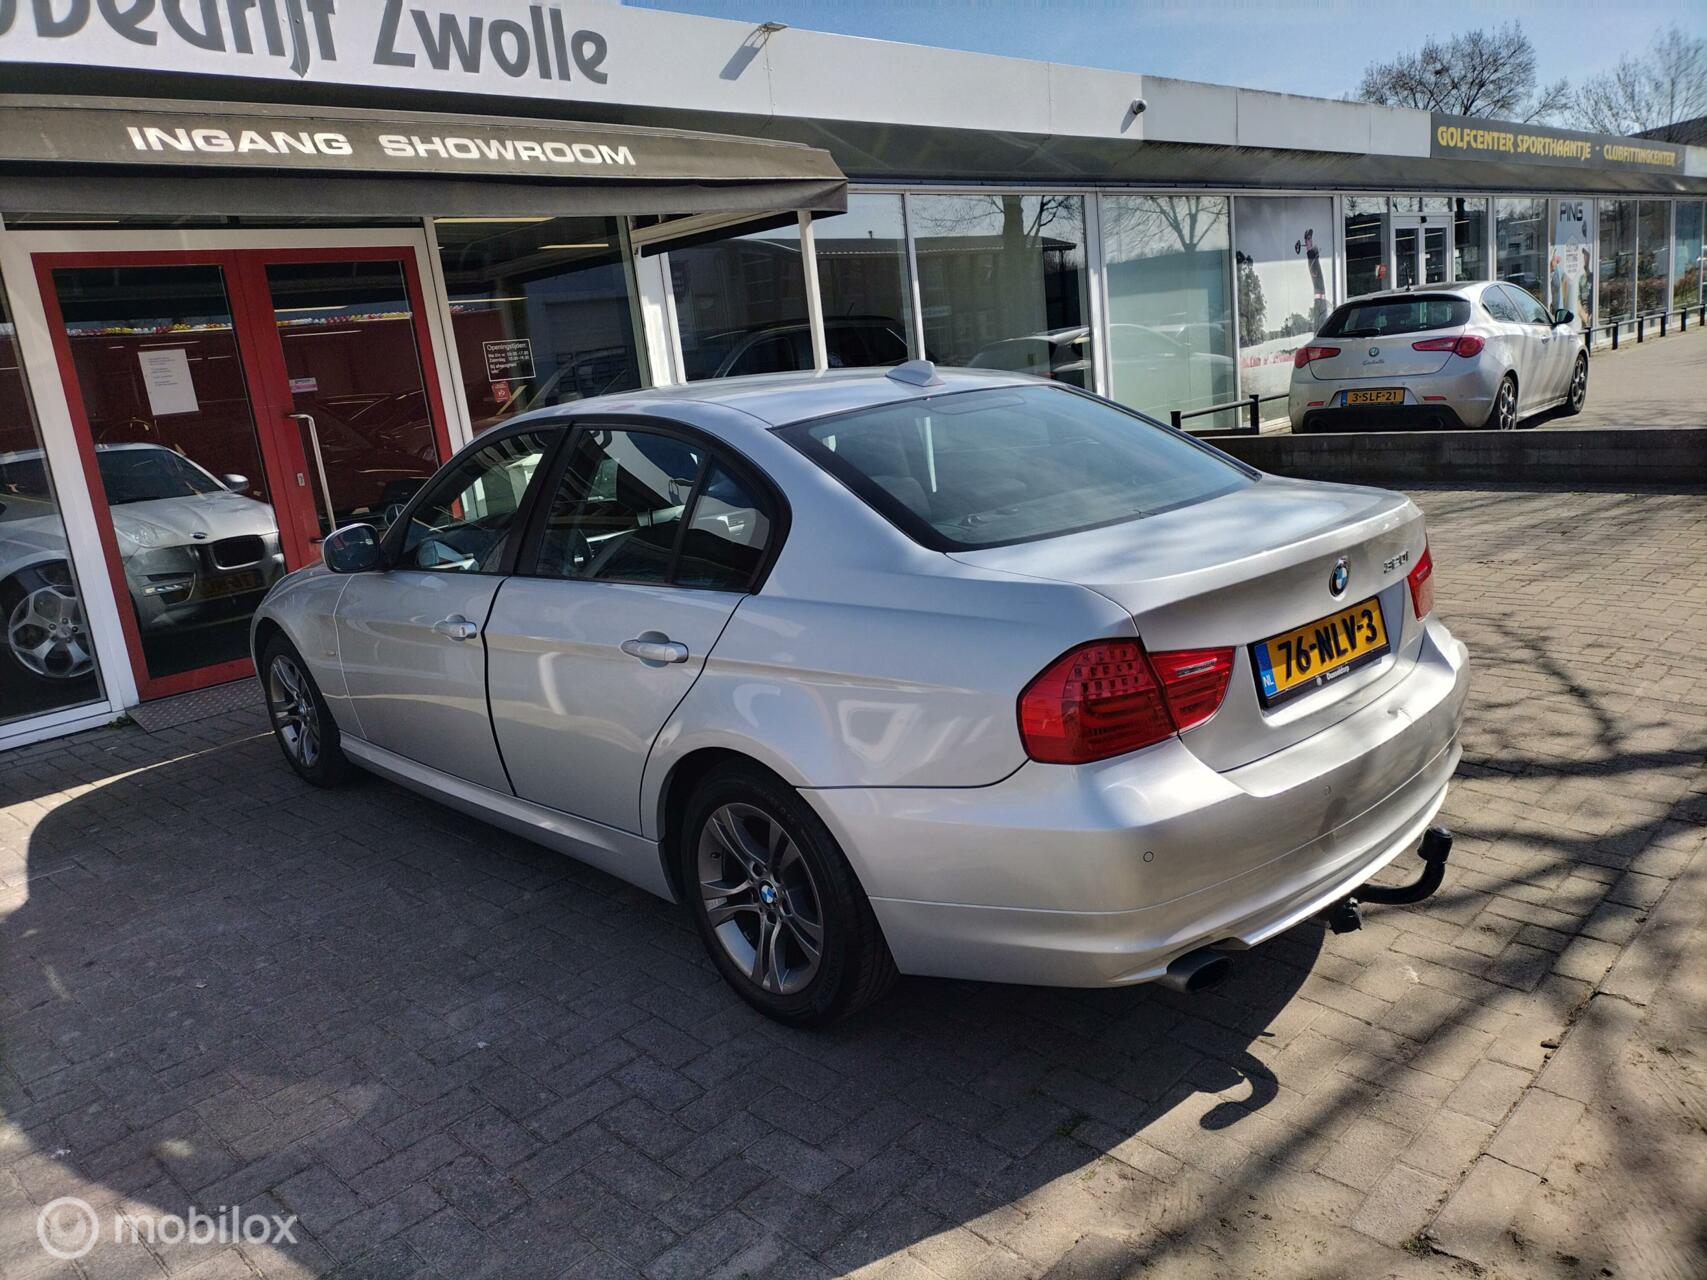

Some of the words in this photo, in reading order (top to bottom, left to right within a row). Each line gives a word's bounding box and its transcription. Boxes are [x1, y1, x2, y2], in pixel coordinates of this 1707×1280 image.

[373, 0, 608, 85] Zwolle
[127, 126, 353, 156] INGANG
[379, 135, 636, 166] SHOWROOM
[1437, 126, 1514, 152] GOLFCENTER
[1559, 201, 1584, 221] PING
[1352, 391, 1397, 402] 3-SLF-21
[1278, 609, 1378, 682] 76-NLV-3
[1262, 674, 1274, 687] NL
